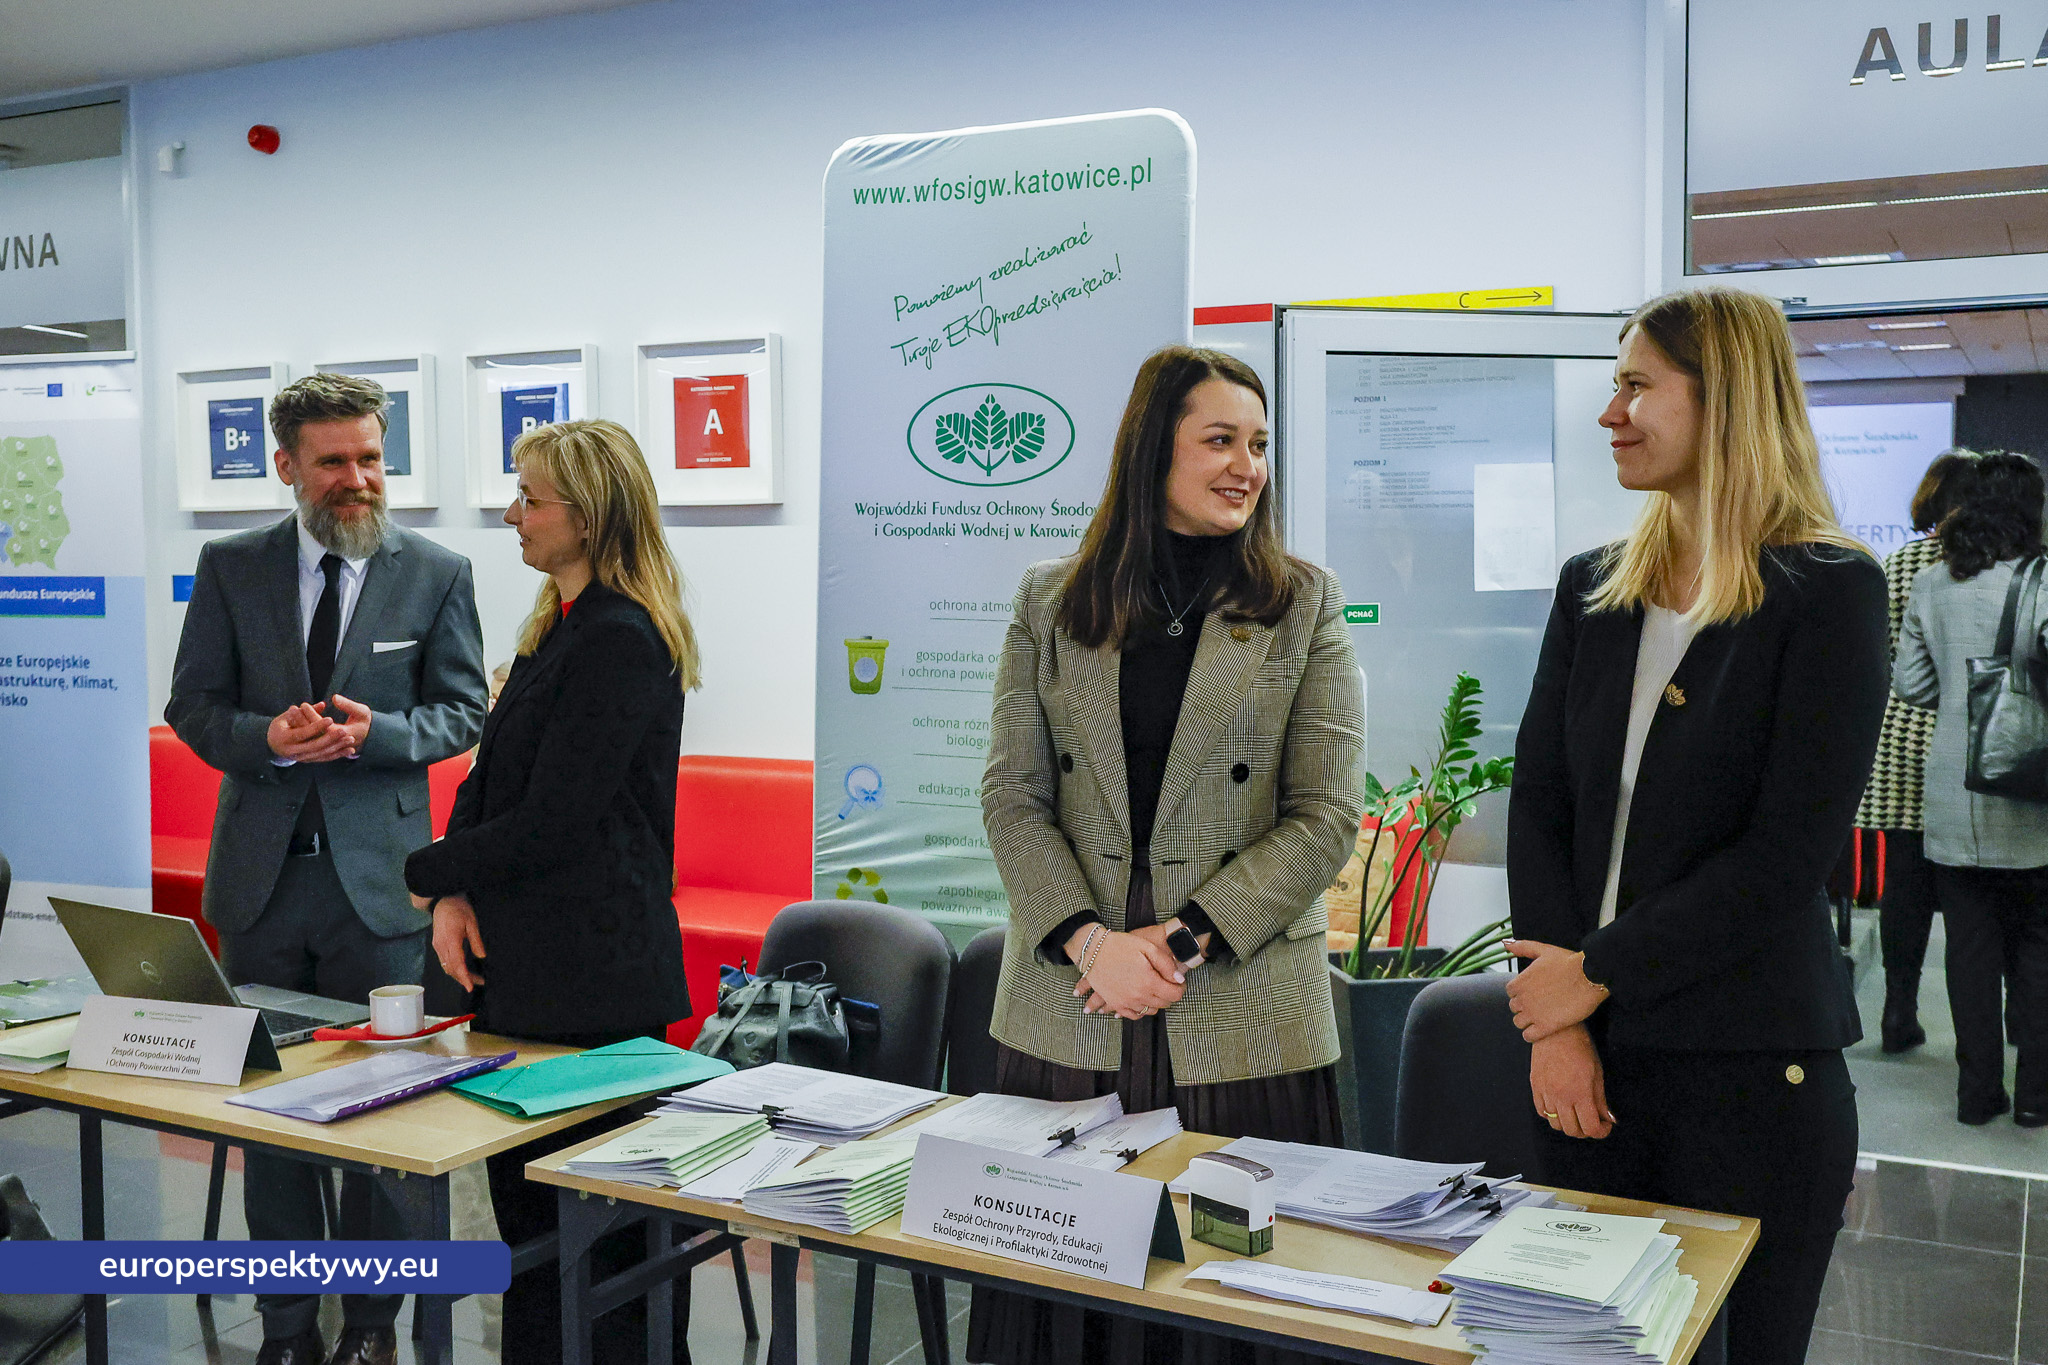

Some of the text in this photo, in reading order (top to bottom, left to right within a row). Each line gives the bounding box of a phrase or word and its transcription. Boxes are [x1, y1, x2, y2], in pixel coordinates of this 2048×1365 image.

[853, 157, 1152, 205] www.wfosigw.katowice.pl
[988, 221, 1093, 281] zrealizować
[1459, 292, 1470, 308] C
[890, 337, 942, 370] Twoje
[703, 408, 724, 435] A
[225, 427, 251, 451] B+
[874, 523, 878, 536] i
[1030, 523, 1086, 538] Katowic
[1844, 524, 1908, 543] ERTY
[40, 588, 96, 602] Europejskie
[929, 599, 1012, 612] ochrona atmo
[1347, 609, 1374, 619] PCHAĆ
[17, 654, 91, 672] Europejskie
[916, 650, 984, 663] gospodarka
[901, 665, 995, 681] i ochrona powie
[72, 675, 118, 691] Klimat,
[0, 691, 28, 707] isko
[912, 716, 989, 731] ochrona różn
[918, 783, 970, 798] edukacja
[937, 886, 1006, 902] zapobiegan
[921, 900, 1010, 919] poważnym awa
[122, 1032, 197, 1050] KONSULTACJE
[111, 1047, 201, 1065] Zespół Gospodarki Wodnej
[109, 1058, 138, 1071] Ochrony
[139, 1062, 180, 1075] Powierzchni
[181, 1066, 201, 1076] Ziemi
[973, 1194, 1077, 1228] KONSULTACJE
[942, 1208, 1103, 1254] Zespół Ochrony Przyrody, Edukacji
[932, 1222, 1109, 1274] Ekologicznej i Profilaktyki Zdrowotnej
